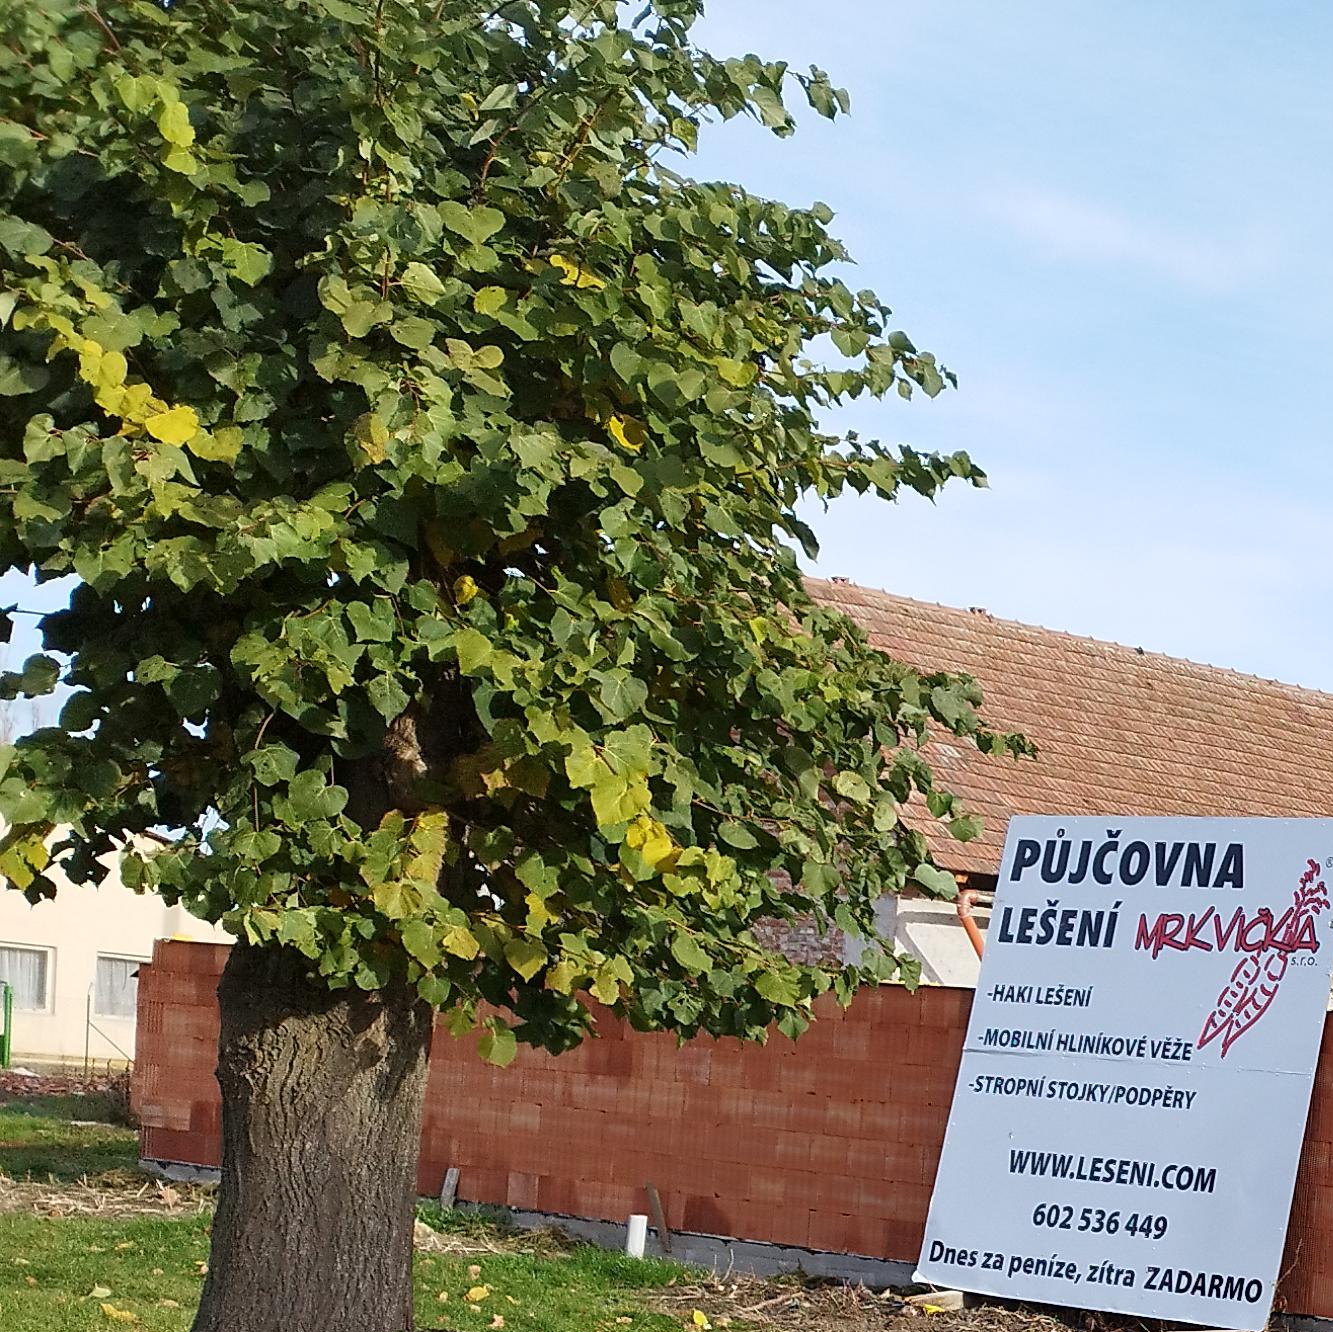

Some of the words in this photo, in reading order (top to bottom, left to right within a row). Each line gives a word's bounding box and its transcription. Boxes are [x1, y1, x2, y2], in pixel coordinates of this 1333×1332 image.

[1010, 828, 1244, 888] PŮJČOVNA
[998, 900, 1123, 948] LEŠENÍ
[1290, 956, 1319, 967] s.r.o.
[987, 984, 1033, 1003] -HAKI
[1035, 984, 1094, 1007] LEŠENÍ
[978, 1028, 1056, 1050] -MOBILNÍ
[1056, 1032, 1147, 1058] HLINÍKOVÉ
[1150, 1036, 1193, 1061] VĚŽE
[968, 1075, 1046, 1097] -STROPNÍ
[1047, 1080, 1197, 1110] STOJKY/PODPĚRY
[1008, 1149, 1217, 1193] WWW.LESENI.COM
[1032, 1203, 1073, 1230] 602
[1077, 1208, 1120, 1235] 536
[1124, 1213, 1168, 1240] 449
[928, 1240, 978, 1268] Dnes
[981, 1250, 1005, 1270] za
[1008, 1254, 1082, 1284] peníze,
[1087, 1260, 1135, 1288] zítra
[1143, 1265, 1264, 1303] ZADARMO
